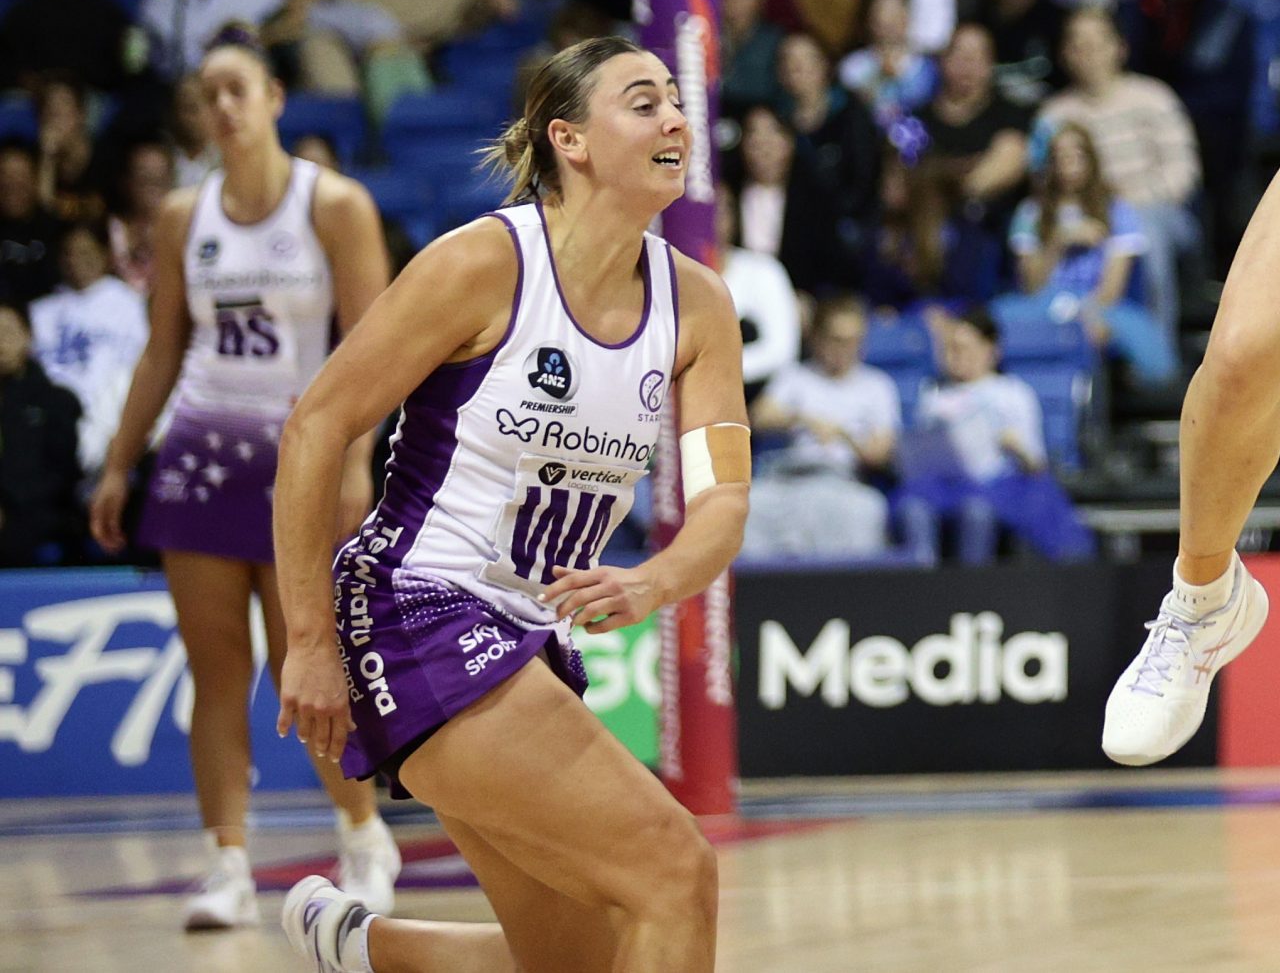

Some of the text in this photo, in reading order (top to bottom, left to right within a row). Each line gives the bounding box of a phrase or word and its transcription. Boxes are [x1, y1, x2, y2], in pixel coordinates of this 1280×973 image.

[536, 373, 566, 389] ANZ
[520, 400, 576, 415] PREMIERSHIP
[571, 469, 628, 484] vertical
[368, 525, 404, 555] Te
[464, 639, 518, 677] SPORT
[758, 611, 1070, 709] Media
[359, 651, 398, 717] Ora
